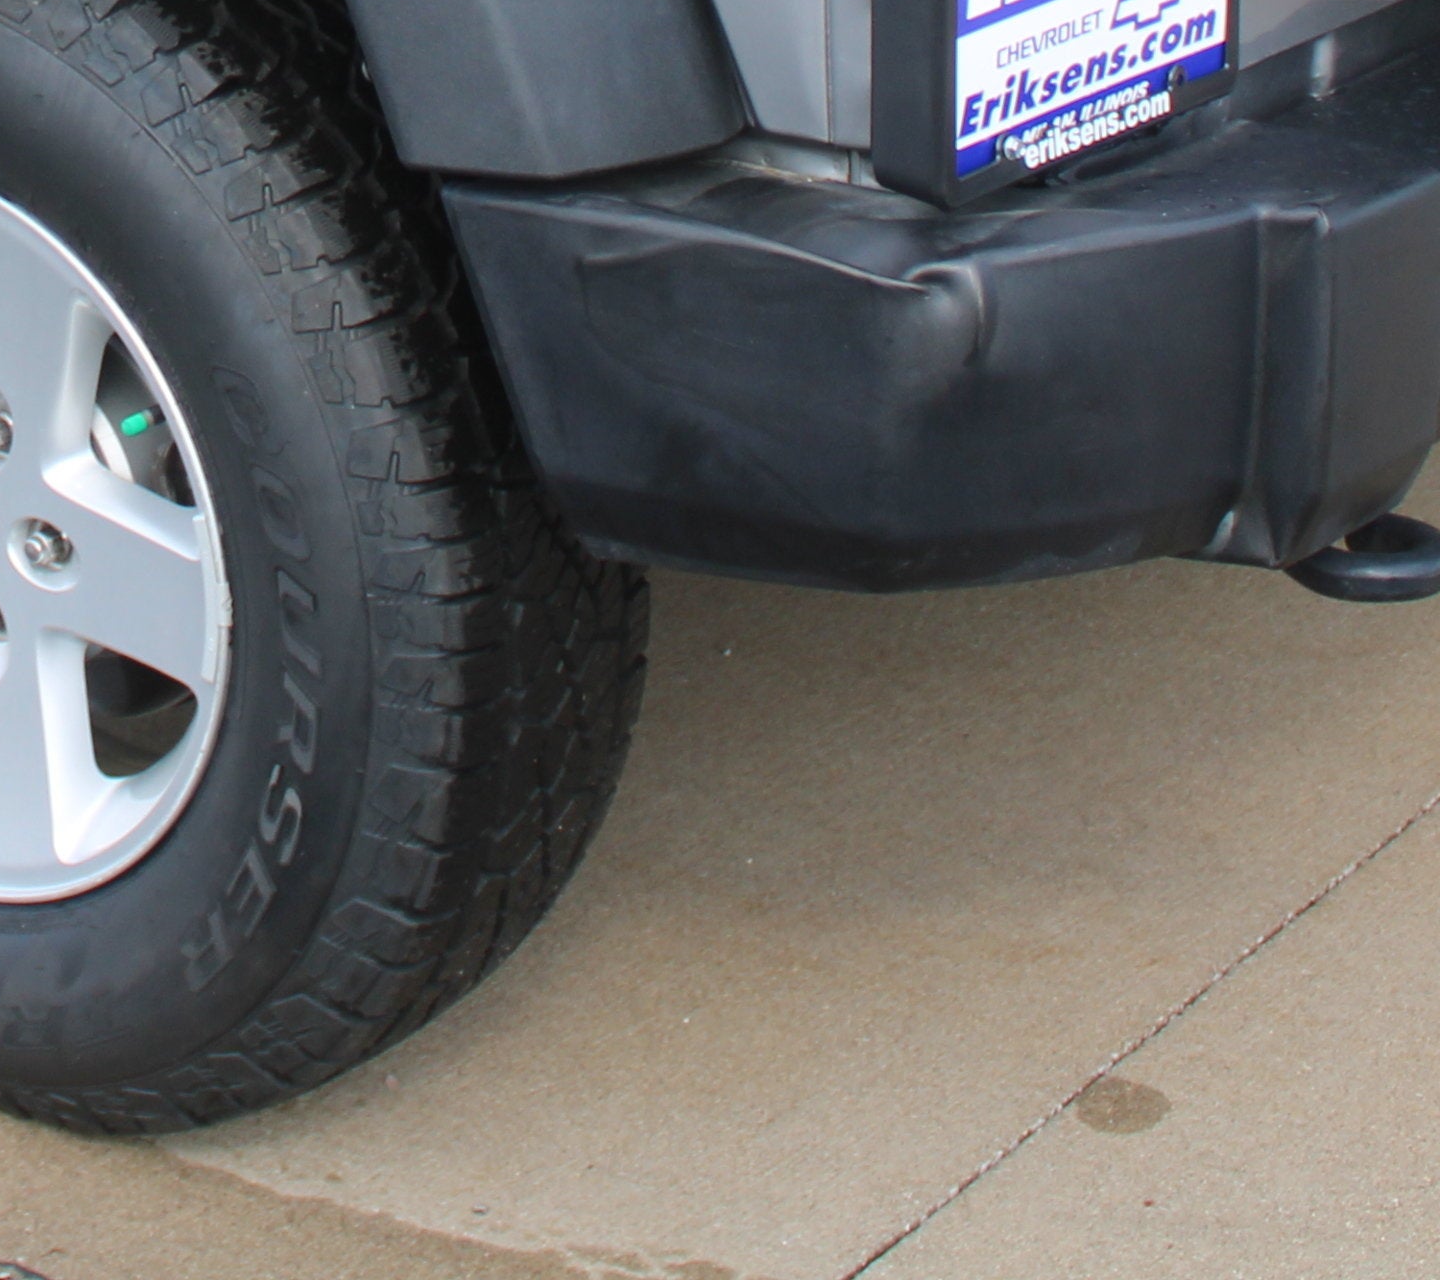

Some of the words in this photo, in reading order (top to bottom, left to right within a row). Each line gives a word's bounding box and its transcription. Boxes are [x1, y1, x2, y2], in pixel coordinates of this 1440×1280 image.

[959, 9, 1217, 140] Eriksens.com
[996, 8, 1104, 70] CHEVROLET
[1023, 90, 1171, 170] eriksens.com
[180, 365, 320, 992] COURSER
